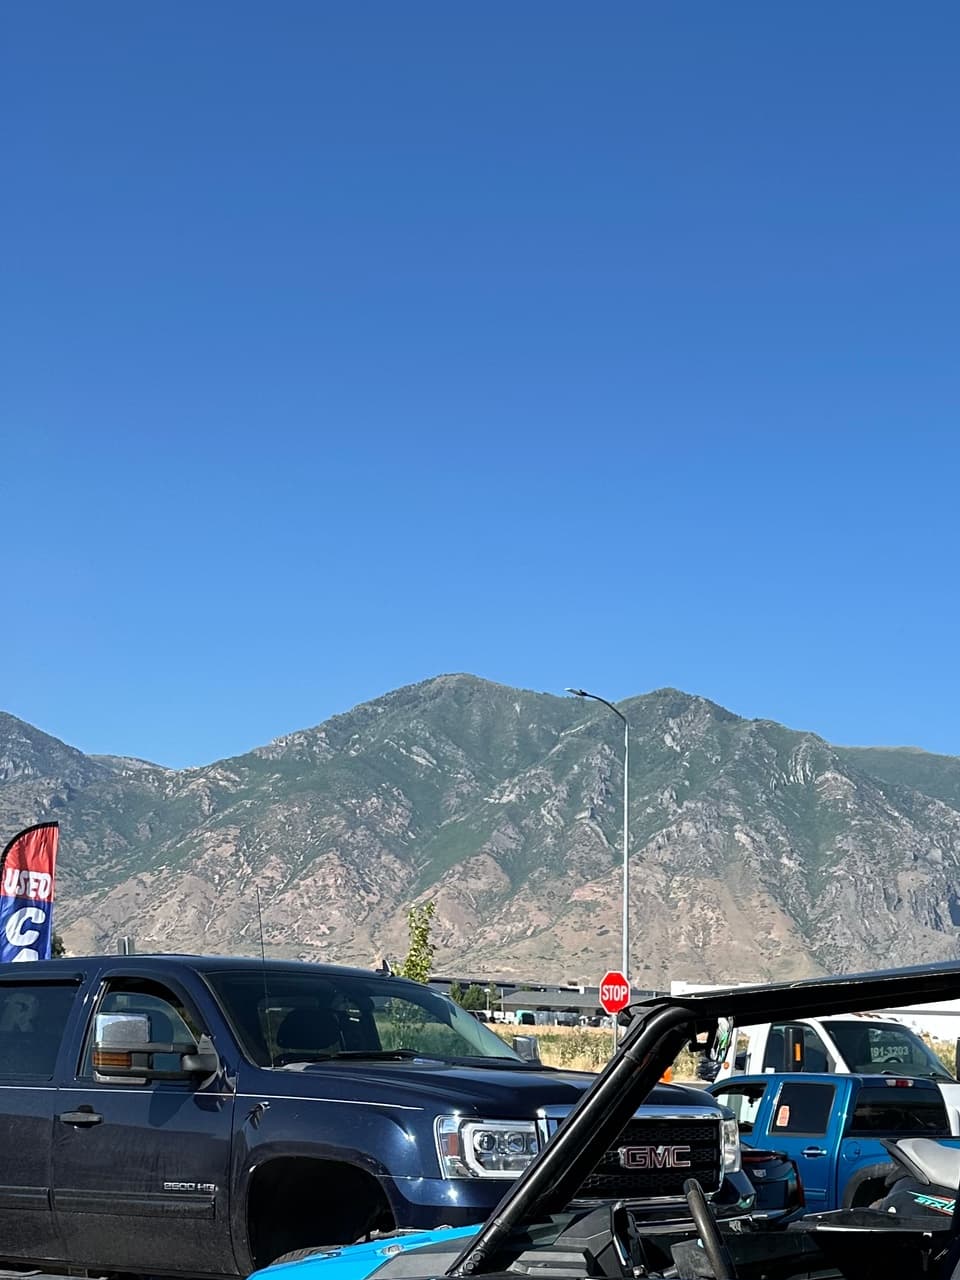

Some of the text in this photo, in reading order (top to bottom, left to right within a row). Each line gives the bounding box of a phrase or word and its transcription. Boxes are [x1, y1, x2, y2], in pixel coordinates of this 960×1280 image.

[4, 868, 52, 899] USED
[602, 984, 628, 1001] STOP
[870, 1046, 909, 1057] 91-3203
[624, 1145, 691, 1169] GMC
